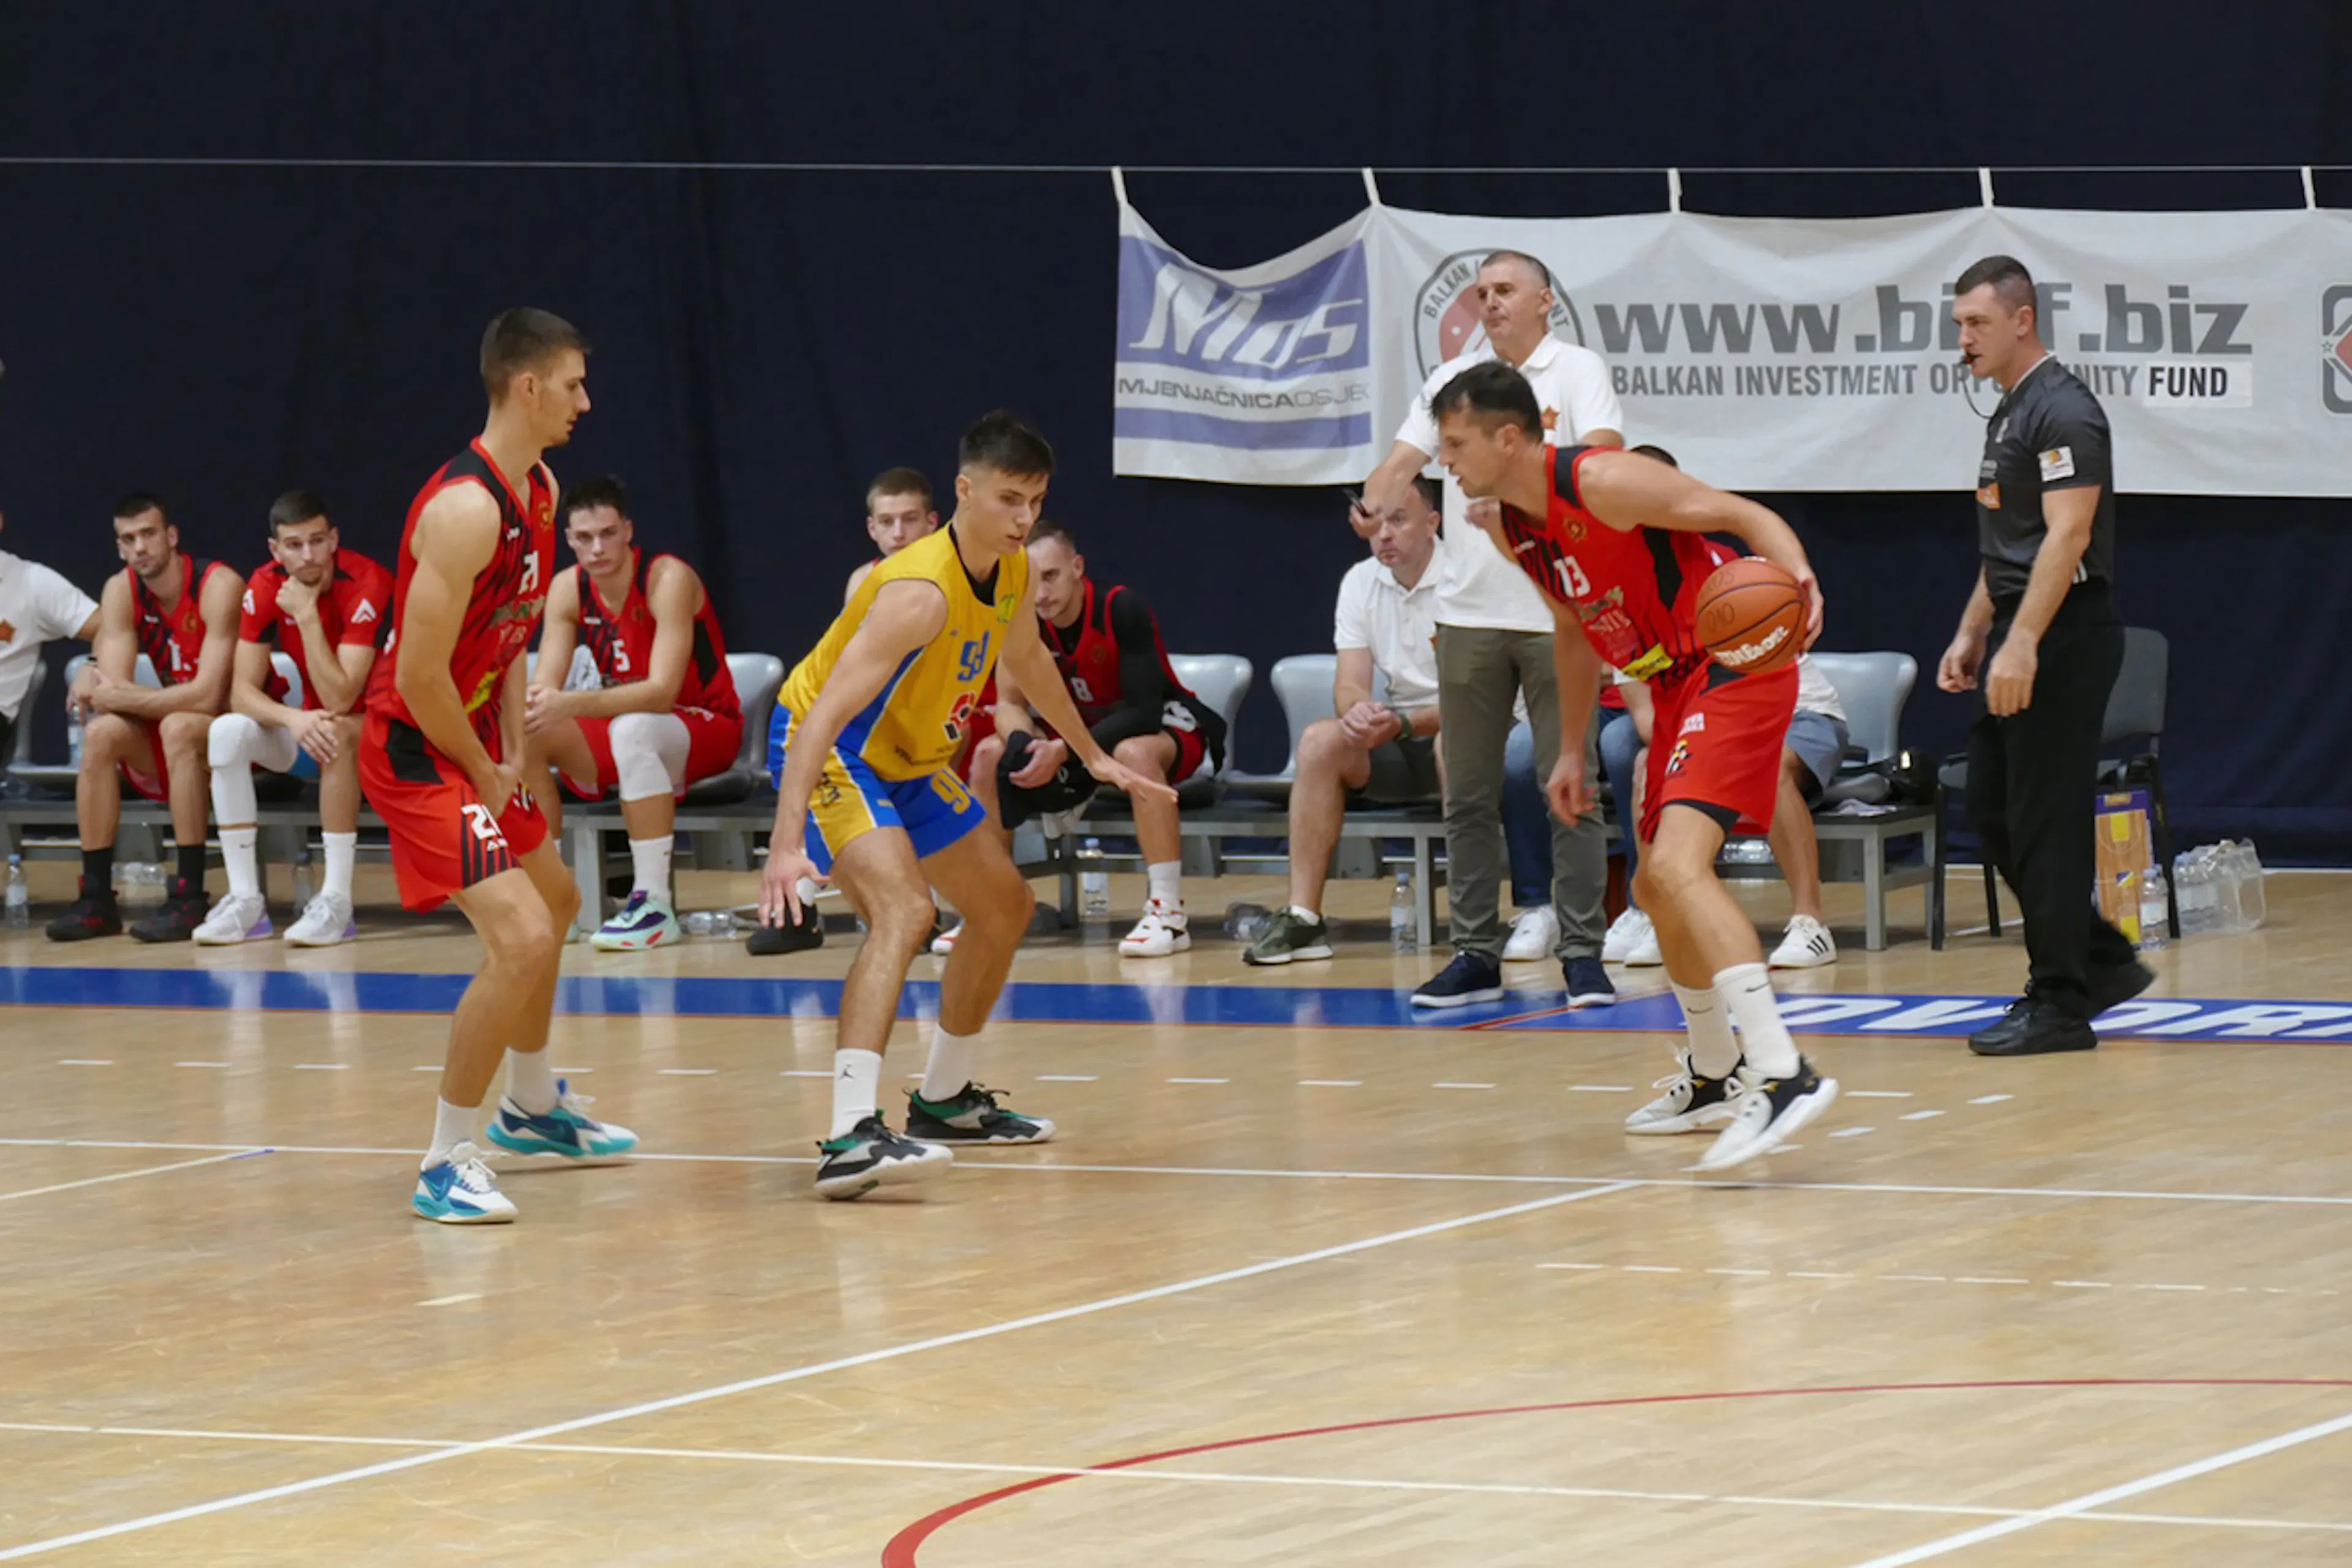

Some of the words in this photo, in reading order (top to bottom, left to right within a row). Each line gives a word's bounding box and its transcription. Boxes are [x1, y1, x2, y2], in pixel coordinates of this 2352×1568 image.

[1423, 262, 1471, 318] BALKAN
[1594, 282, 2252, 355] www.bif.biz
[1613, 365, 1724, 396] BALKAN
[1736, 364, 1917, 396] INVESTMENT
[2149, 367, 2227, 397] FUND
[1553, 555, 1591, 598] 13
[612, 639, 630, 671] 5
[1070, 676, 1094, 703] 8
